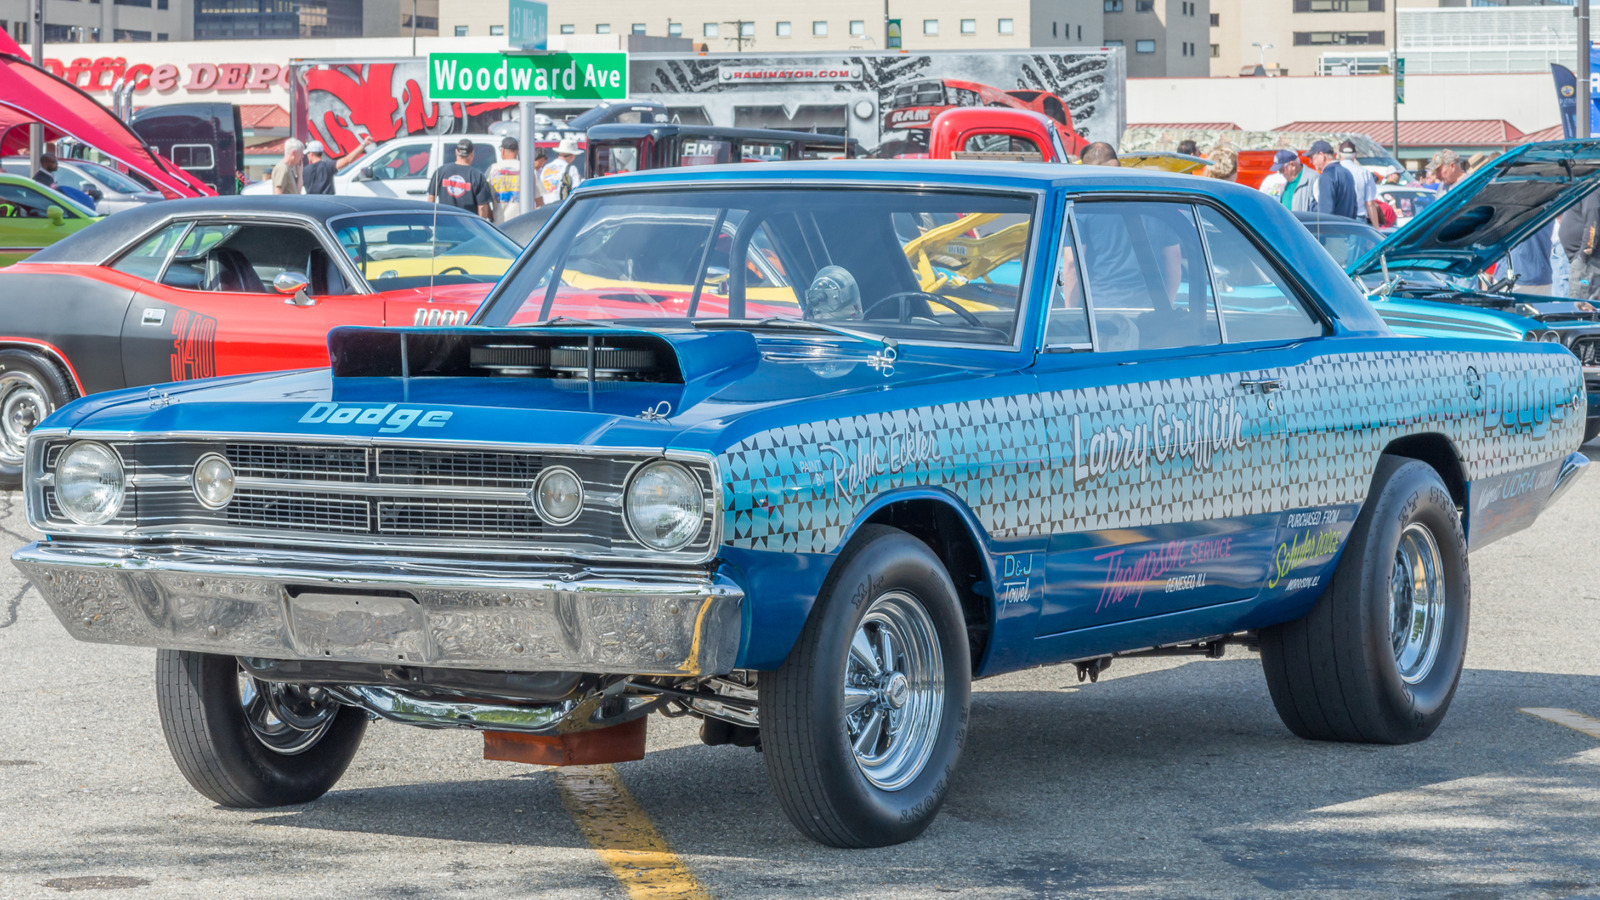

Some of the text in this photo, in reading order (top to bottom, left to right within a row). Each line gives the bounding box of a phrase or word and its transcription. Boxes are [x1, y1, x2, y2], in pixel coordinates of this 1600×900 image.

[434, 59, 621, 91] Woodward Ave
[733, 69, 850, 80] RAMINATOR.COM
[891, 109, 930, 124] RAM
[170, 309, 218, 382] 340
[298, 401, 454, 435] Dodge
[1484, 369, 1564, 441] Dodge
[1072, 396, 1247, 484] Larry Griffith
[800, 459, 822, 474] PAINT
[815, 472, 826, 487] BY
[819, 423, 942, 505] Ralph Eckler
[1286, 509, 1341, 530] PURCHASED FROM
[1314, 528, 1342, 558] DODGE
[1004, 554, 1033, 581] D&J
[1094, 537, 1233, 614] Thompson SERVICE
[1002, 581, 1031, 615] Towel
